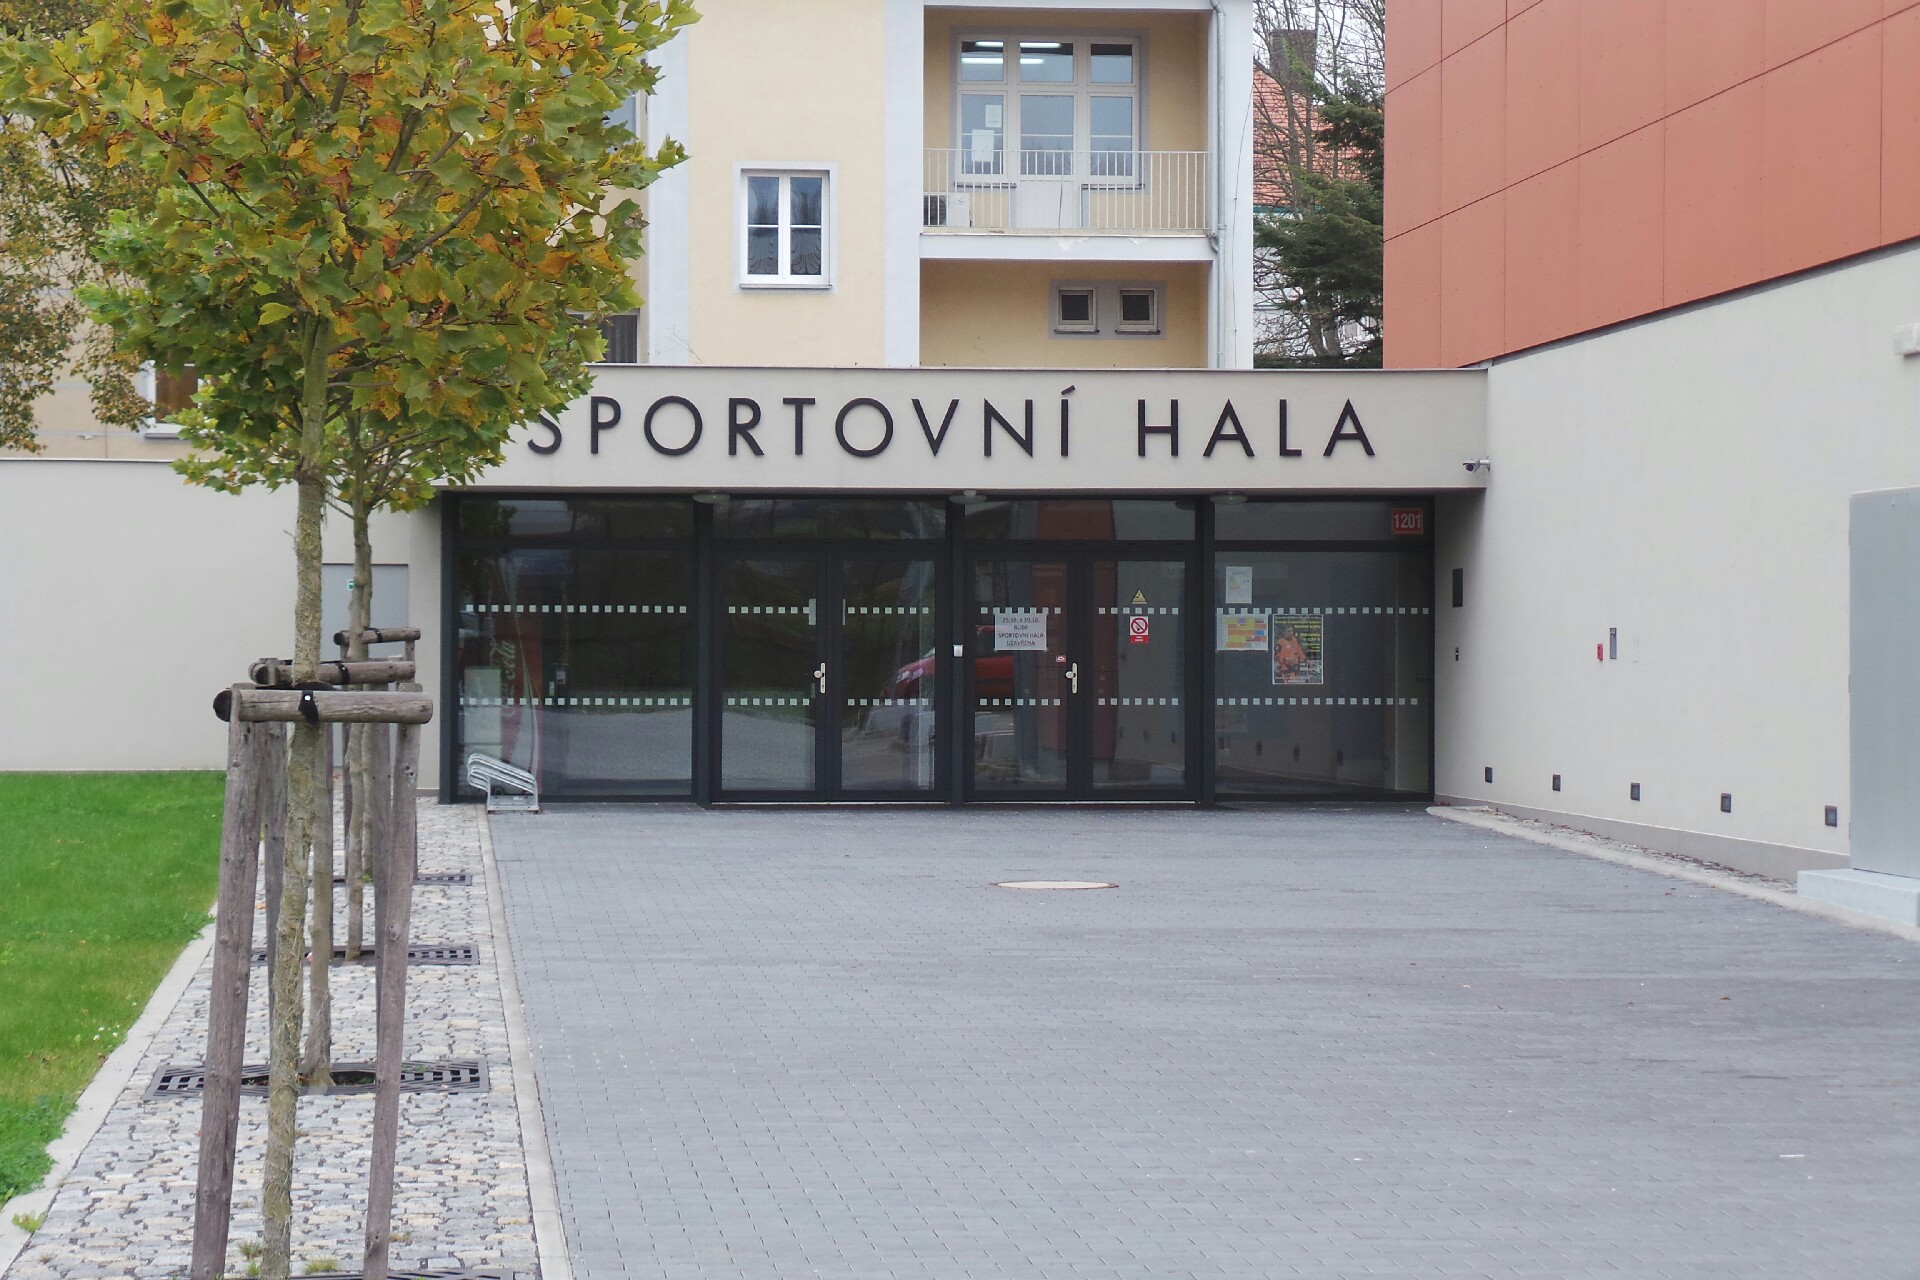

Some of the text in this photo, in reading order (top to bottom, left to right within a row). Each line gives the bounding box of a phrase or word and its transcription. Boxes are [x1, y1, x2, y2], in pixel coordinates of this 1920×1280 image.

[527, 385, 1375, 457] SPORTOVNÍ HALA
[1393, 513, 1420, 529] 1201
